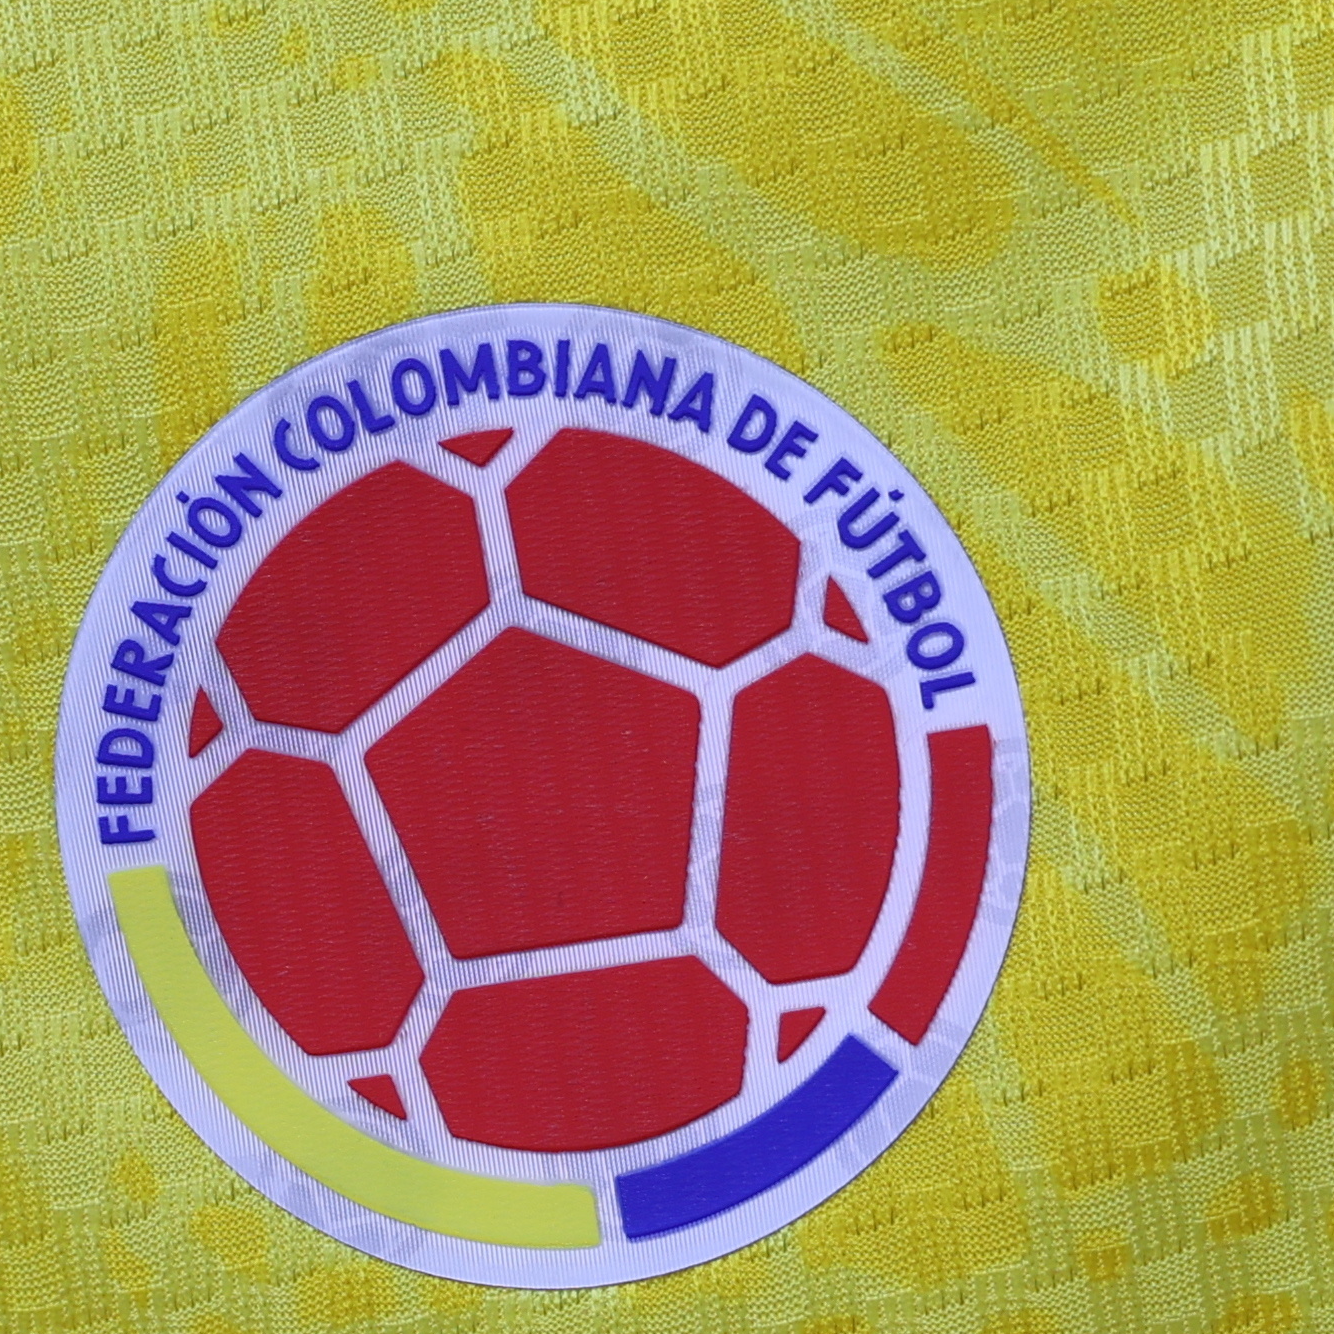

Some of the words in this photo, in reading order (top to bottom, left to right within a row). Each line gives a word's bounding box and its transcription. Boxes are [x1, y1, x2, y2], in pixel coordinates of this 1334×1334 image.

[95, 452, 283, 846] FEDERACIÓN
[273, 339, 715, 473] COLOMBIANA
[727, 394, 819, 482] DE
[804, 457, 976, 711] FÚTBOL
